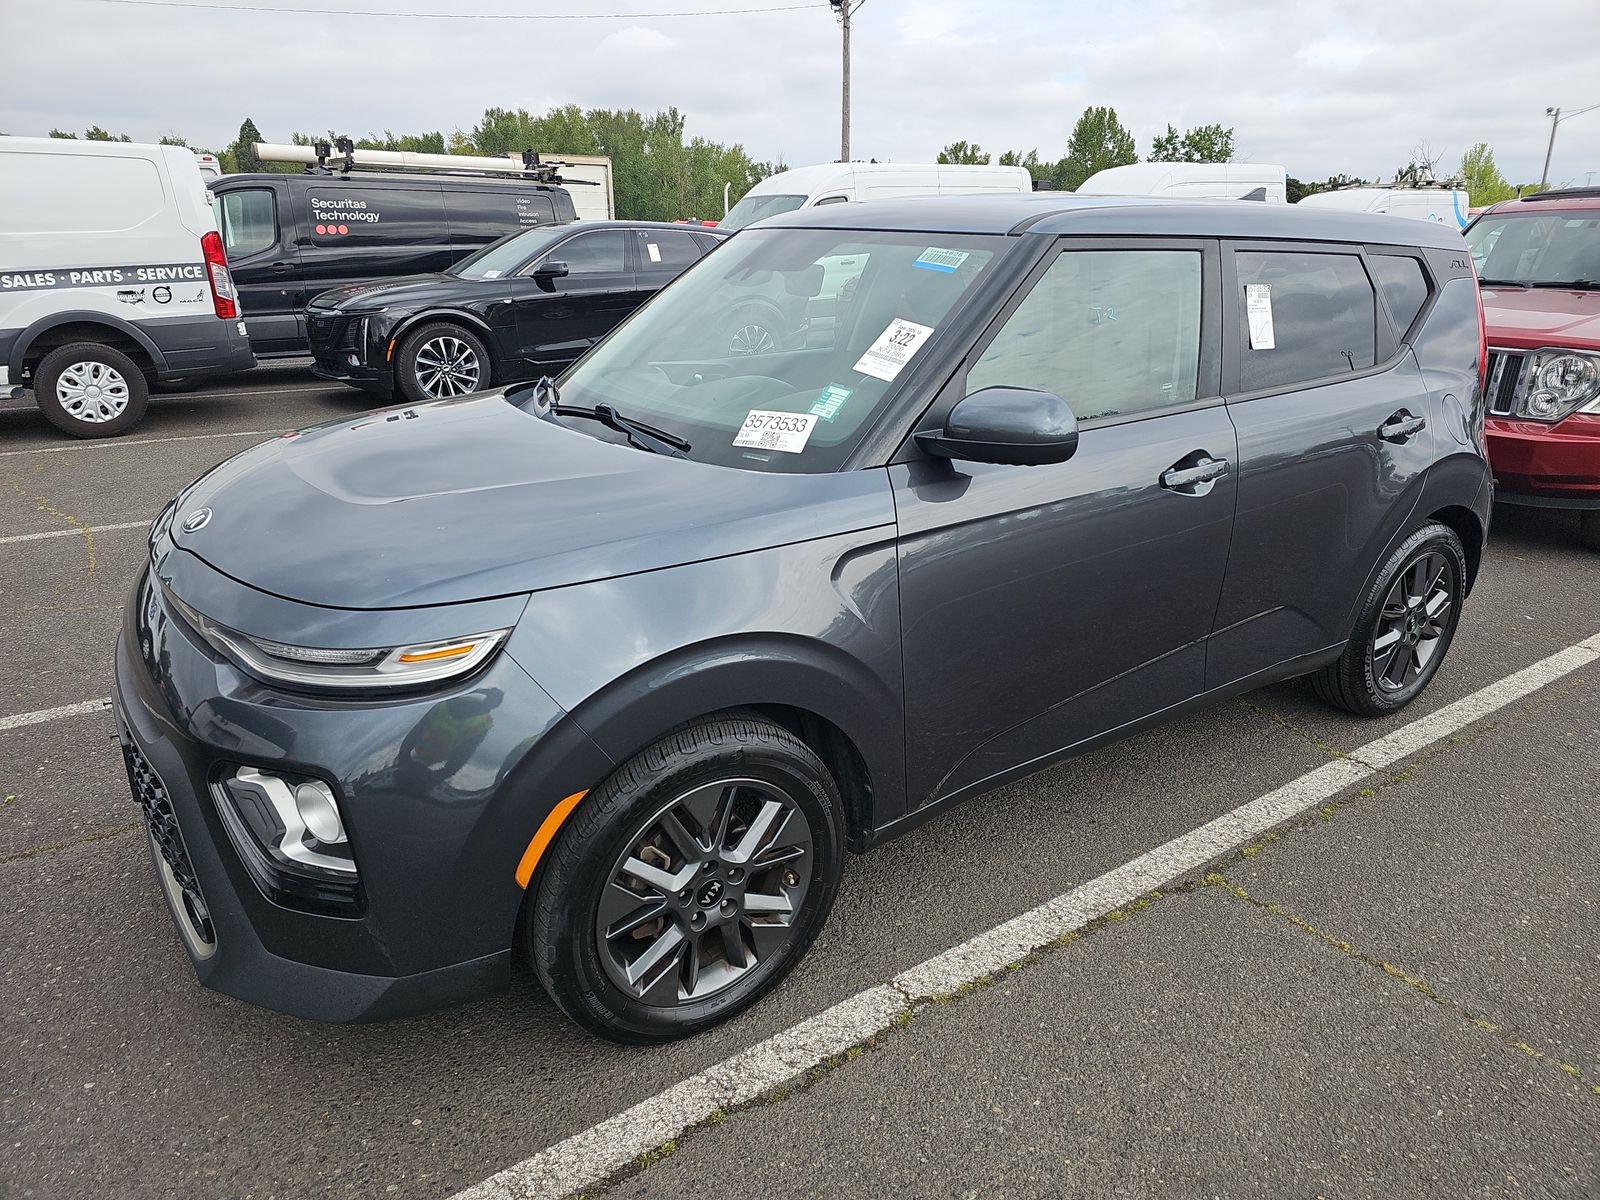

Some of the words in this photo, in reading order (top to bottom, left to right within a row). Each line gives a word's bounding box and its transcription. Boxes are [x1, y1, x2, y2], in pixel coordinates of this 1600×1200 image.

[311, 198, 367, 209] Securitas
[313, 210, 380, 223] Technology
[0, 272, 56, 288] SALES
[69, 269, 123, 285] PARTS
[136, 266, 203, 281] SERVICE
[889, 329, 916, 347] 3:22
[745, 414, 808, 433] 3573533
[701, 881, 722, 904] KIA
